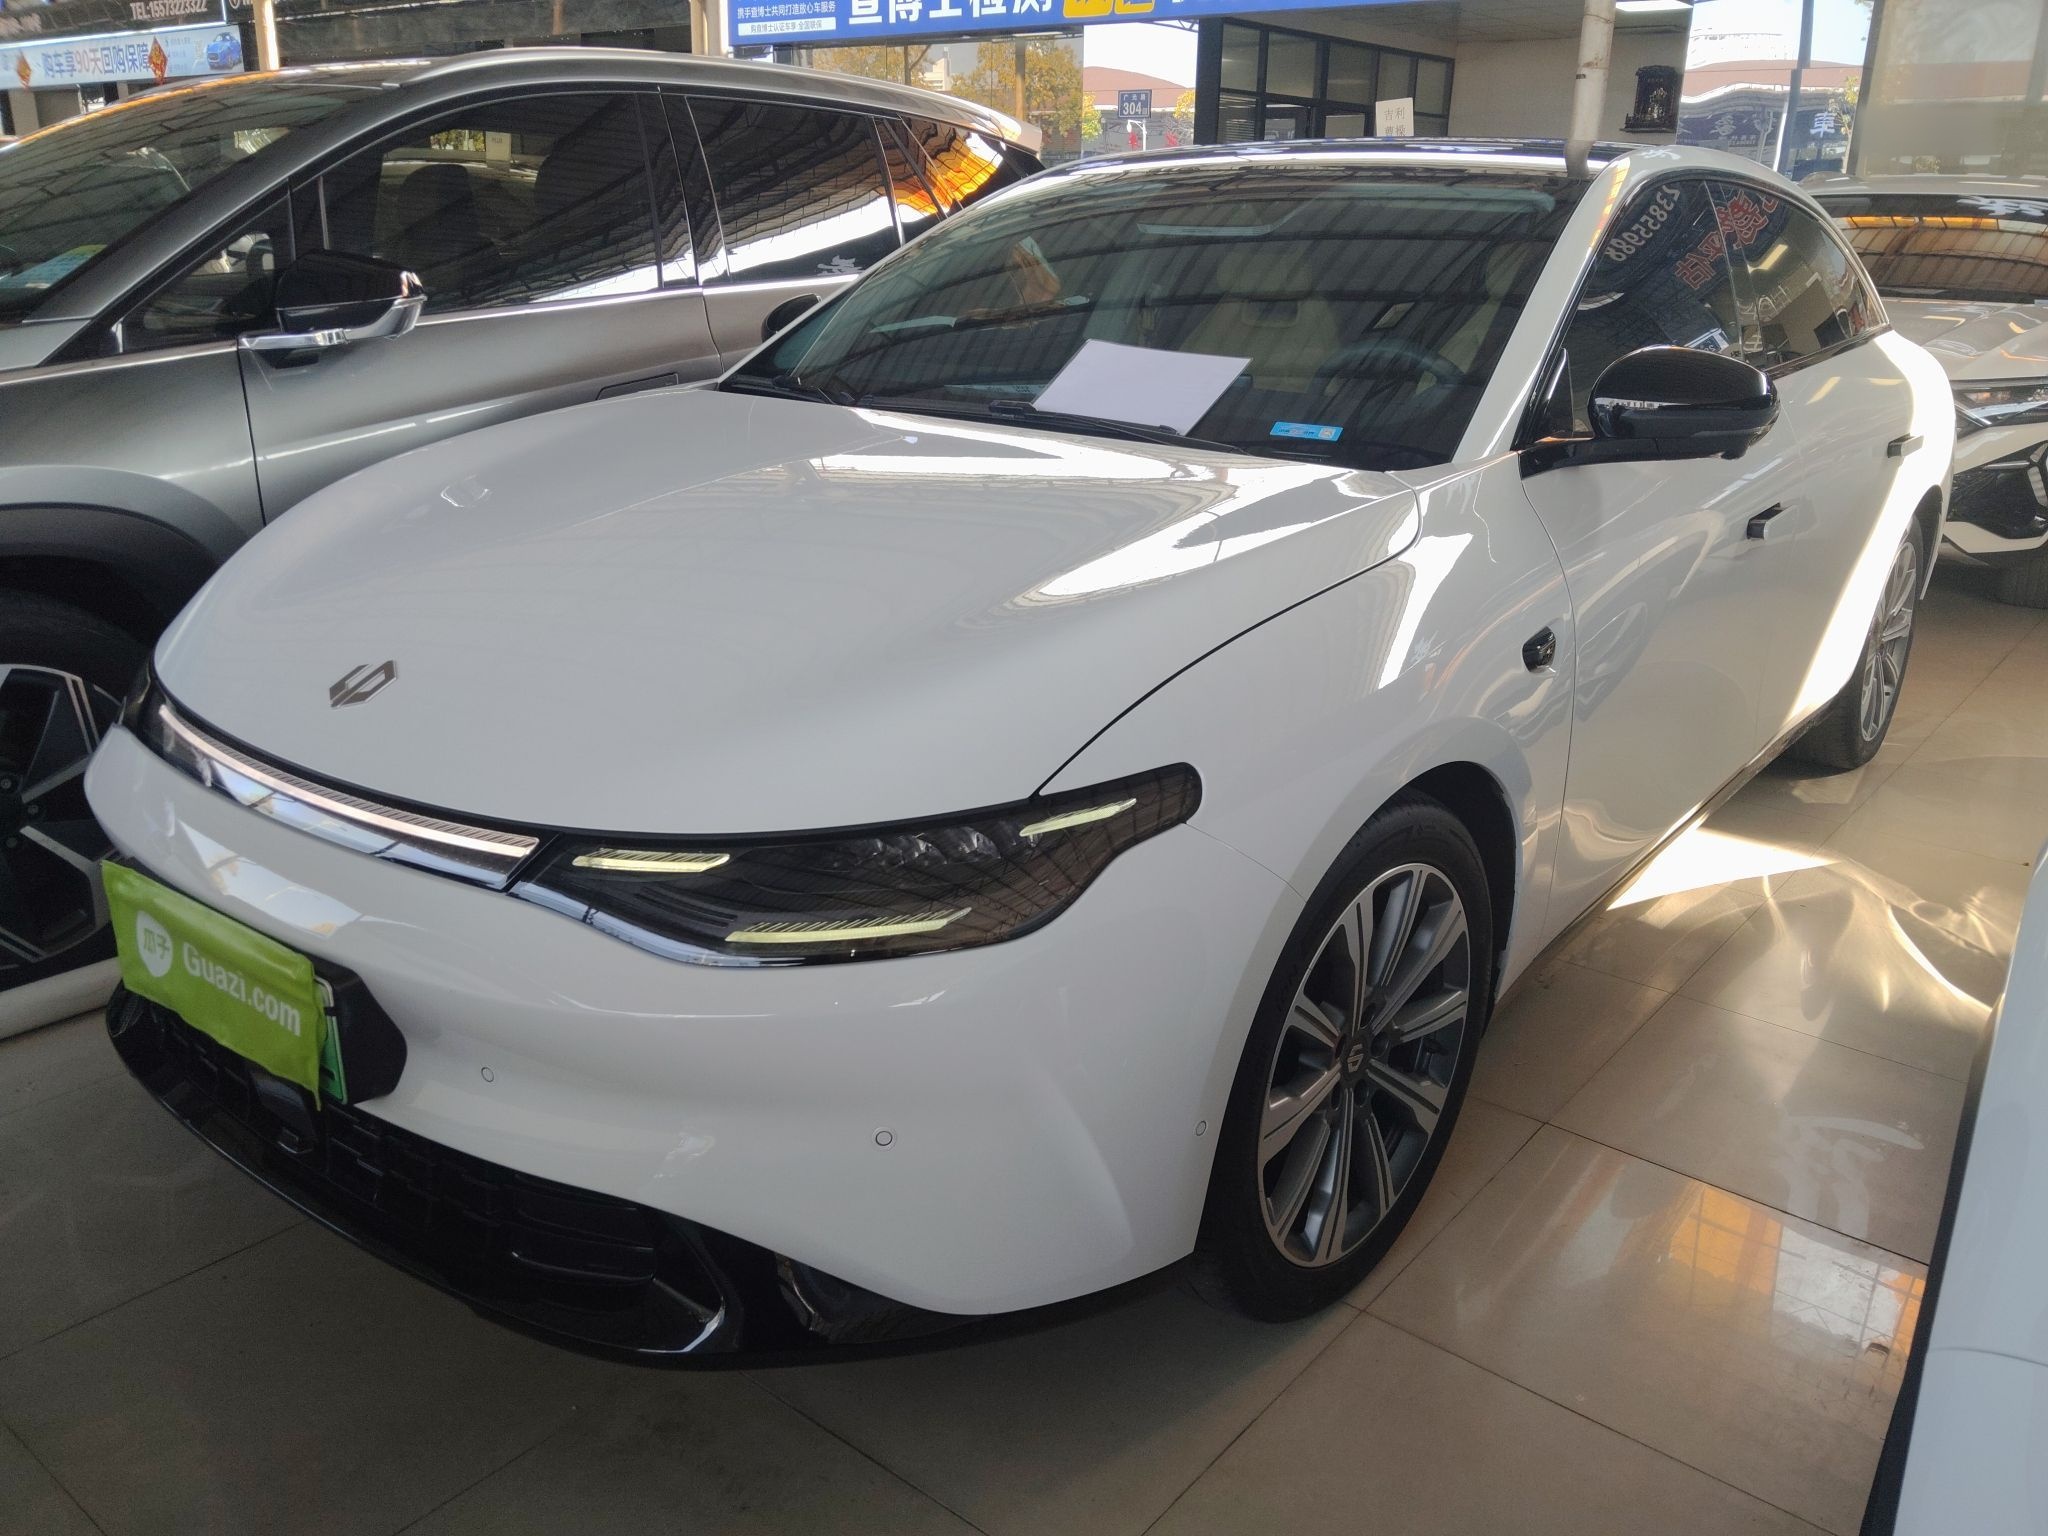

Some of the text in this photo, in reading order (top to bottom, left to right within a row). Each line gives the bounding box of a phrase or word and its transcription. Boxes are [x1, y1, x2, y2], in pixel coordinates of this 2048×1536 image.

[41, 42, 150, 78] 购车享90天回购保障
[142, 928, 171, 961] 瓜子
[182, 942, 301, 1037] Guazi.com
